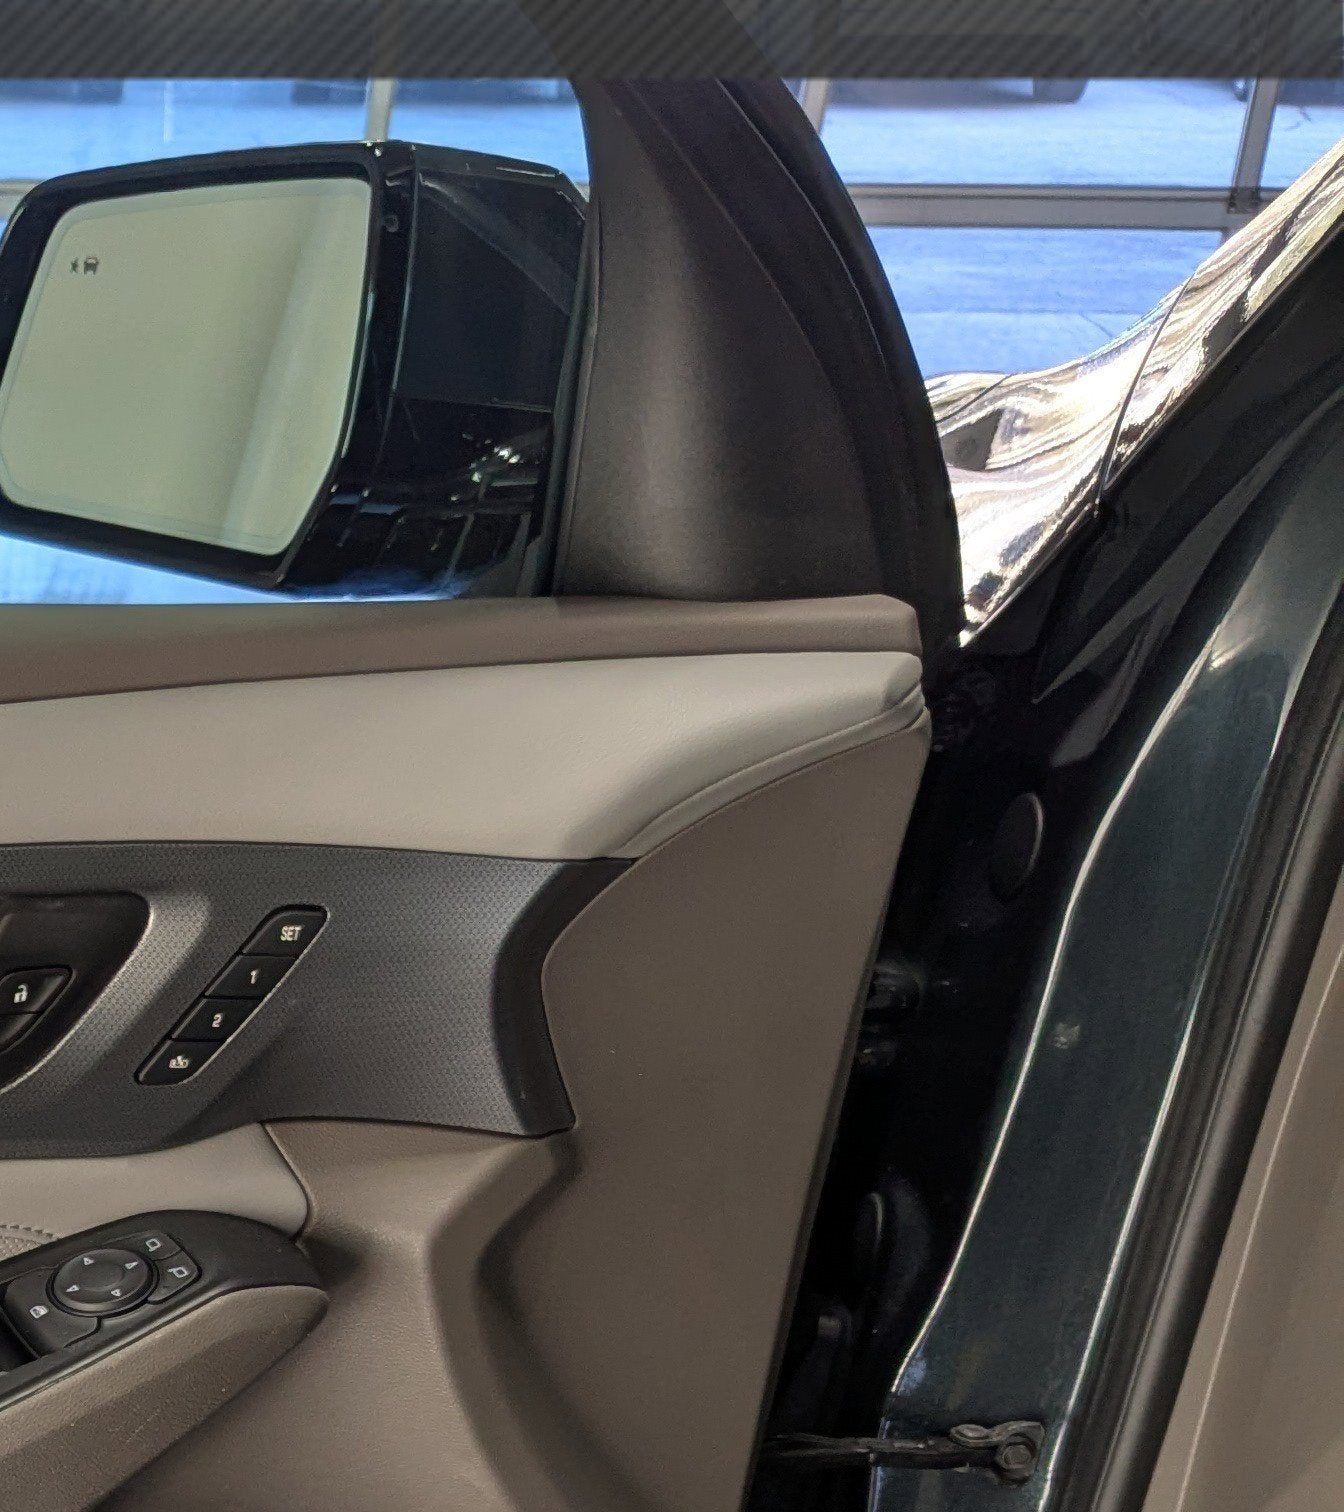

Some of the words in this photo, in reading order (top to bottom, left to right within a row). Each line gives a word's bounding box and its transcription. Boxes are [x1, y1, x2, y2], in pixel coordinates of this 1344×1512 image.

[279, 925, 303, 942] SET
[249, 969, 260, 985] 1
[211, 1012, 223, 1028] 2
